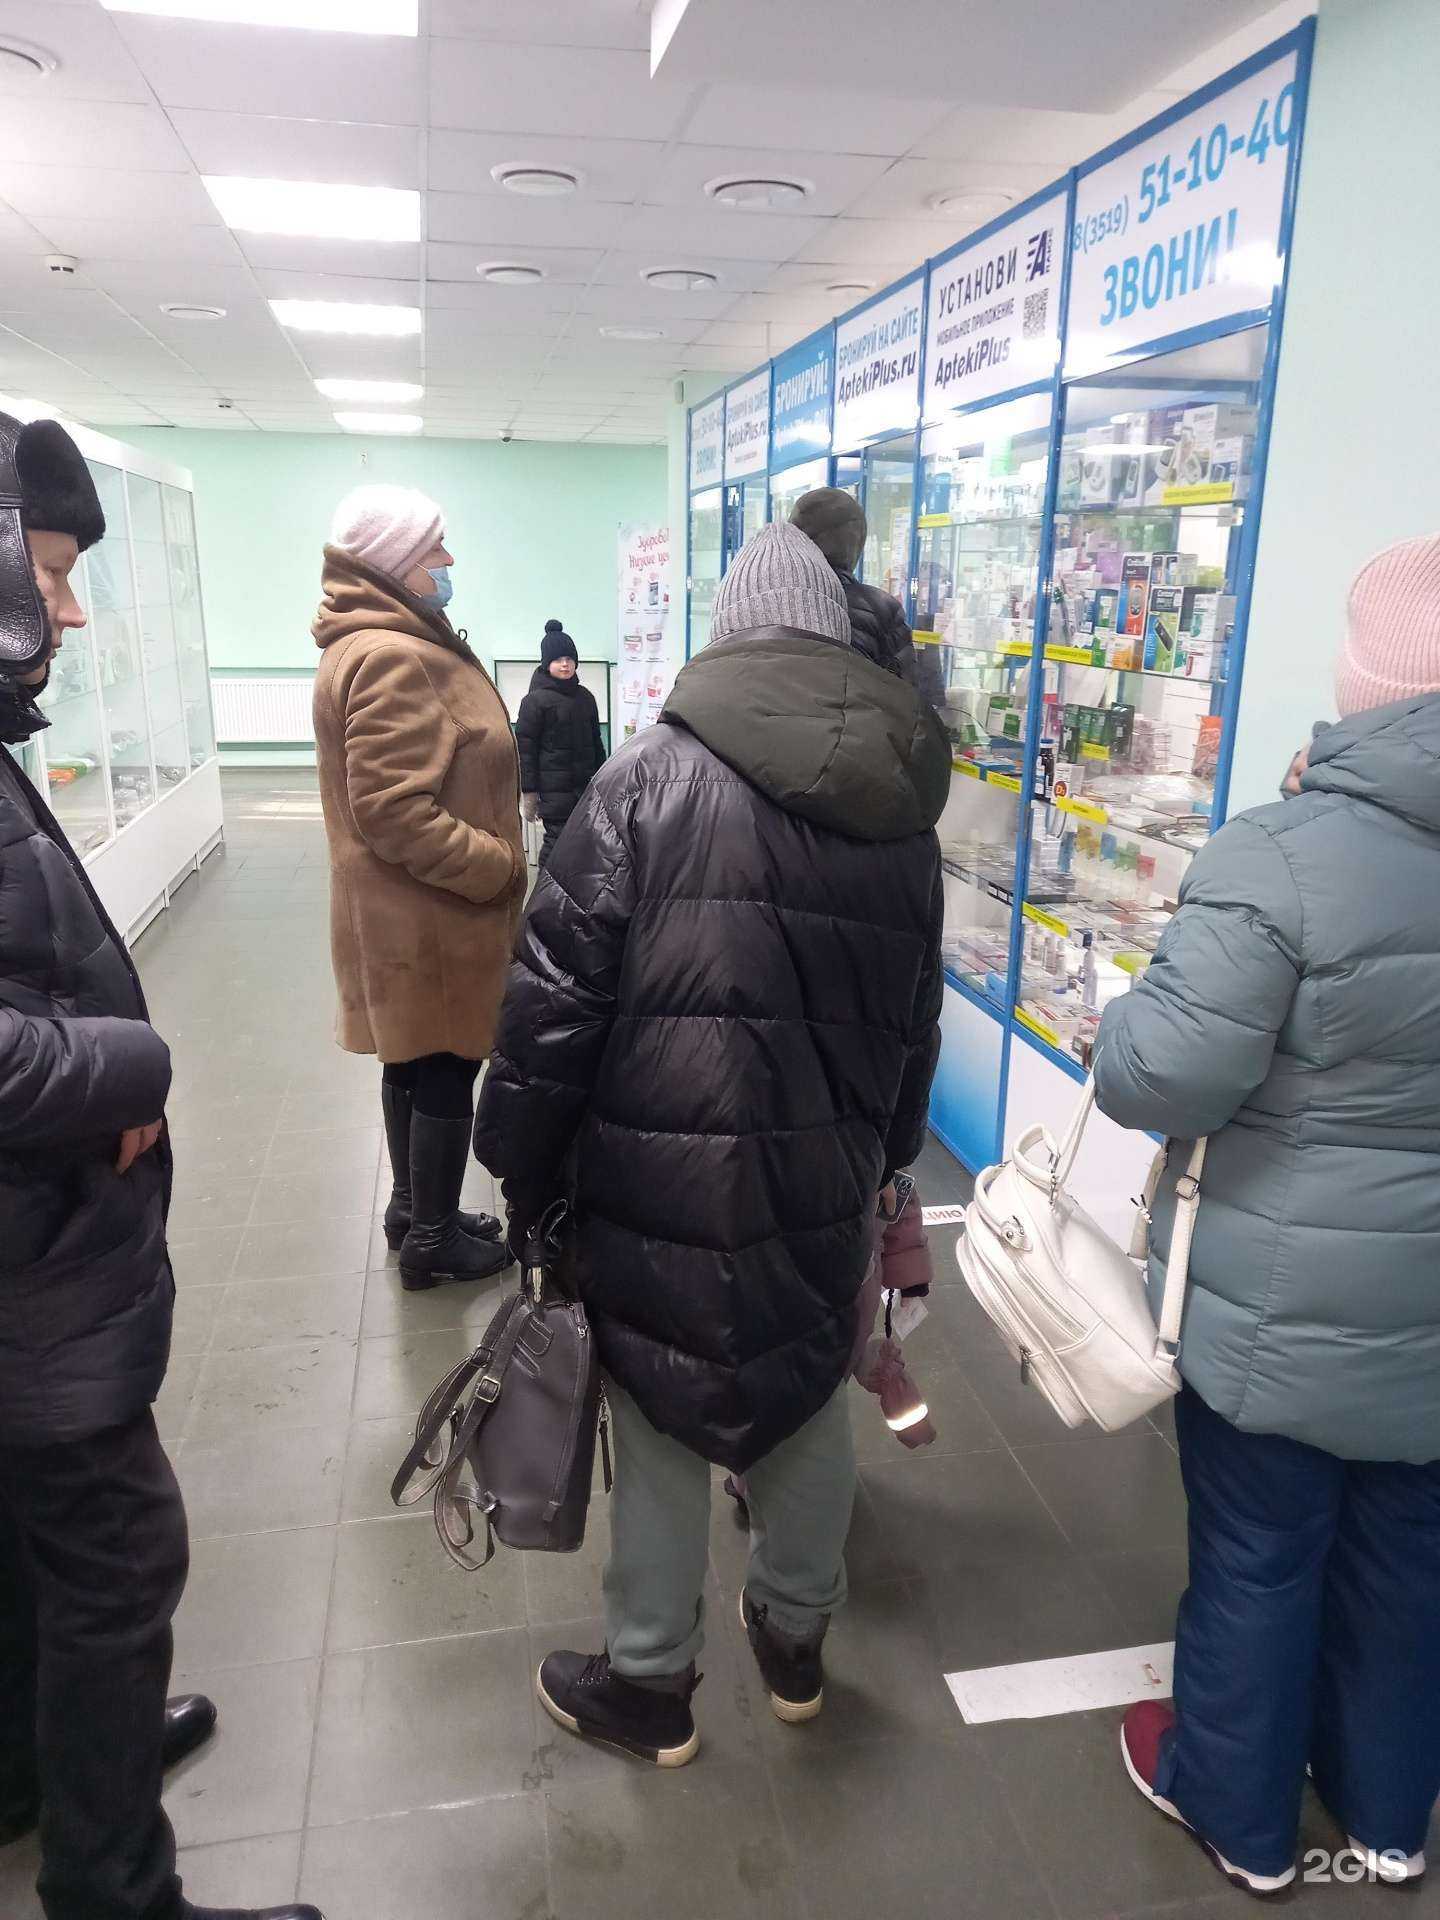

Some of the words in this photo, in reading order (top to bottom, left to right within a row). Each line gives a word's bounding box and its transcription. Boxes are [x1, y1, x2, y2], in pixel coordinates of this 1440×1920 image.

[939, 247, 1017, 319] УСТАНОВИ
[890, 306, 919, 345] САЙТЕ
[775, 350, 829, 417] БРОНИРУЙ!
[838, 351, 917, 408] AptekiPlus.ru
[934, 337, 1011, 390] AptekiPlus
